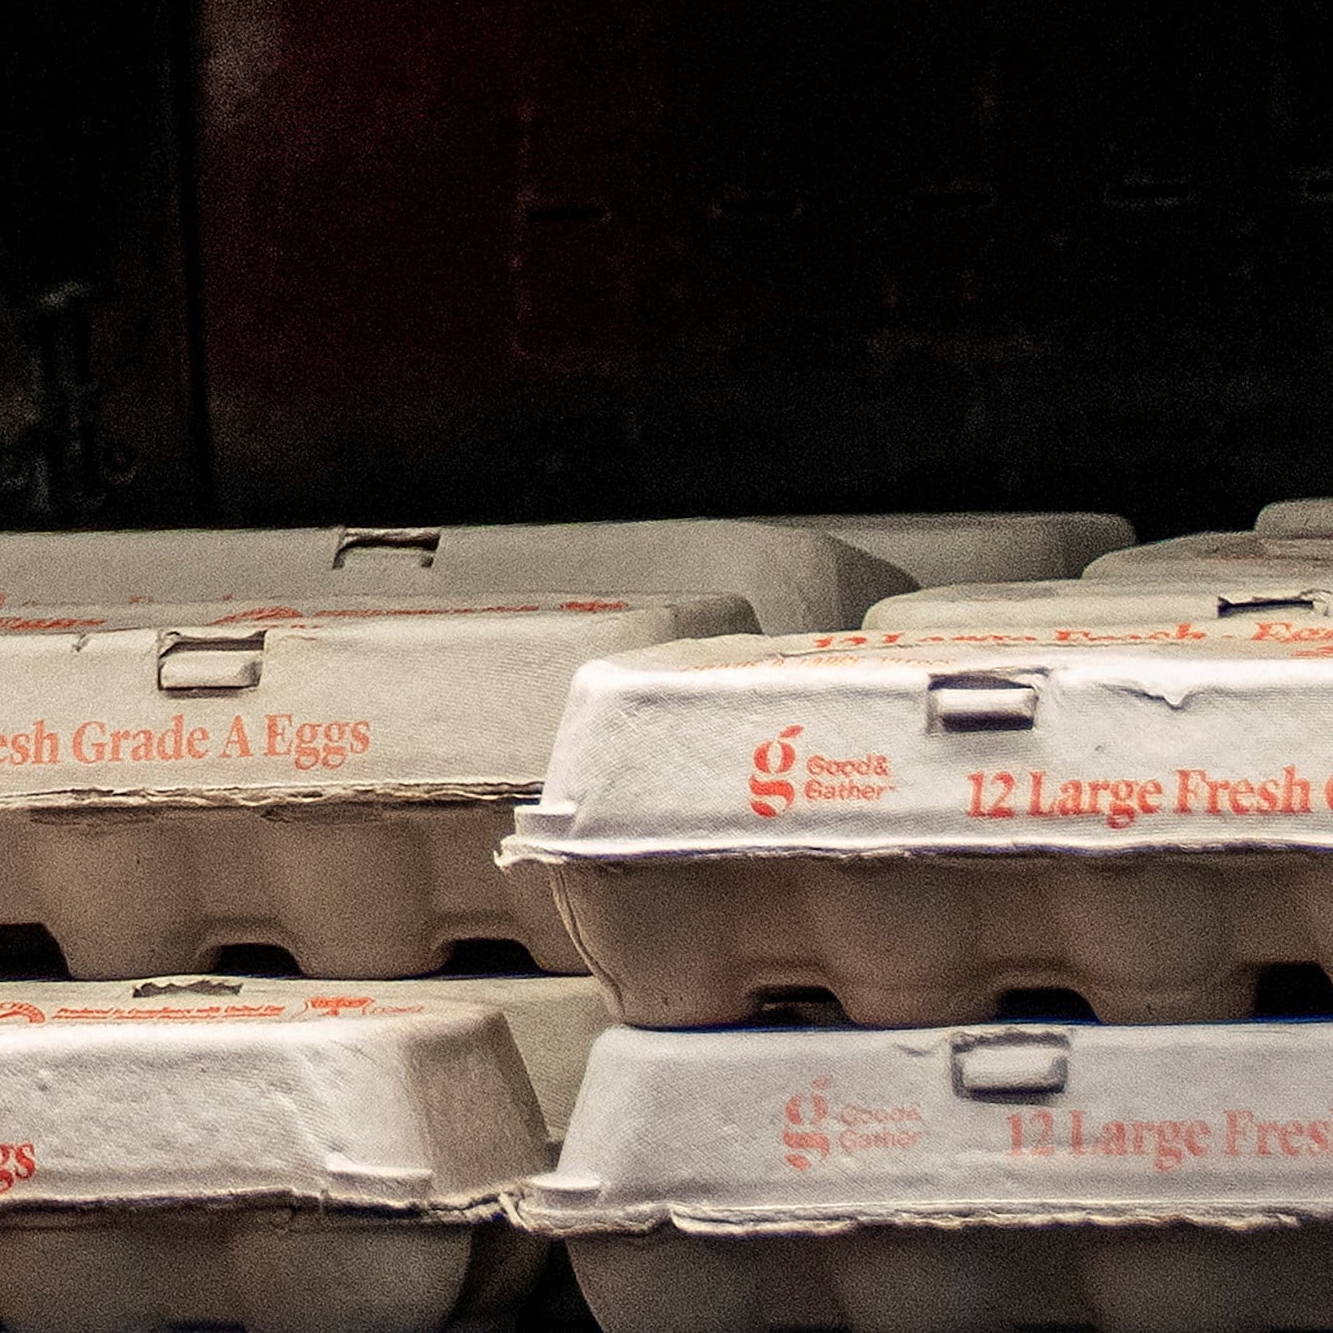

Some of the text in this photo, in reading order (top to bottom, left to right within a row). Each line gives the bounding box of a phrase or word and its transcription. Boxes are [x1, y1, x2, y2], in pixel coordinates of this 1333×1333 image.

[71, 714, 210, 765] Grade
[220, 714, 254, 759] A
[263, 713, 371, 771] Eggs
[806, 753, 890, 777] Good&
[804, 778, 889, 802] Gather
[966, 770, 1016, 819] 12
[1026, 770, 1163, 829] Large
[1174, 765, 1313, 817] Fresh
[1007, 1109, 1333, 1172] 12 Large Fres
